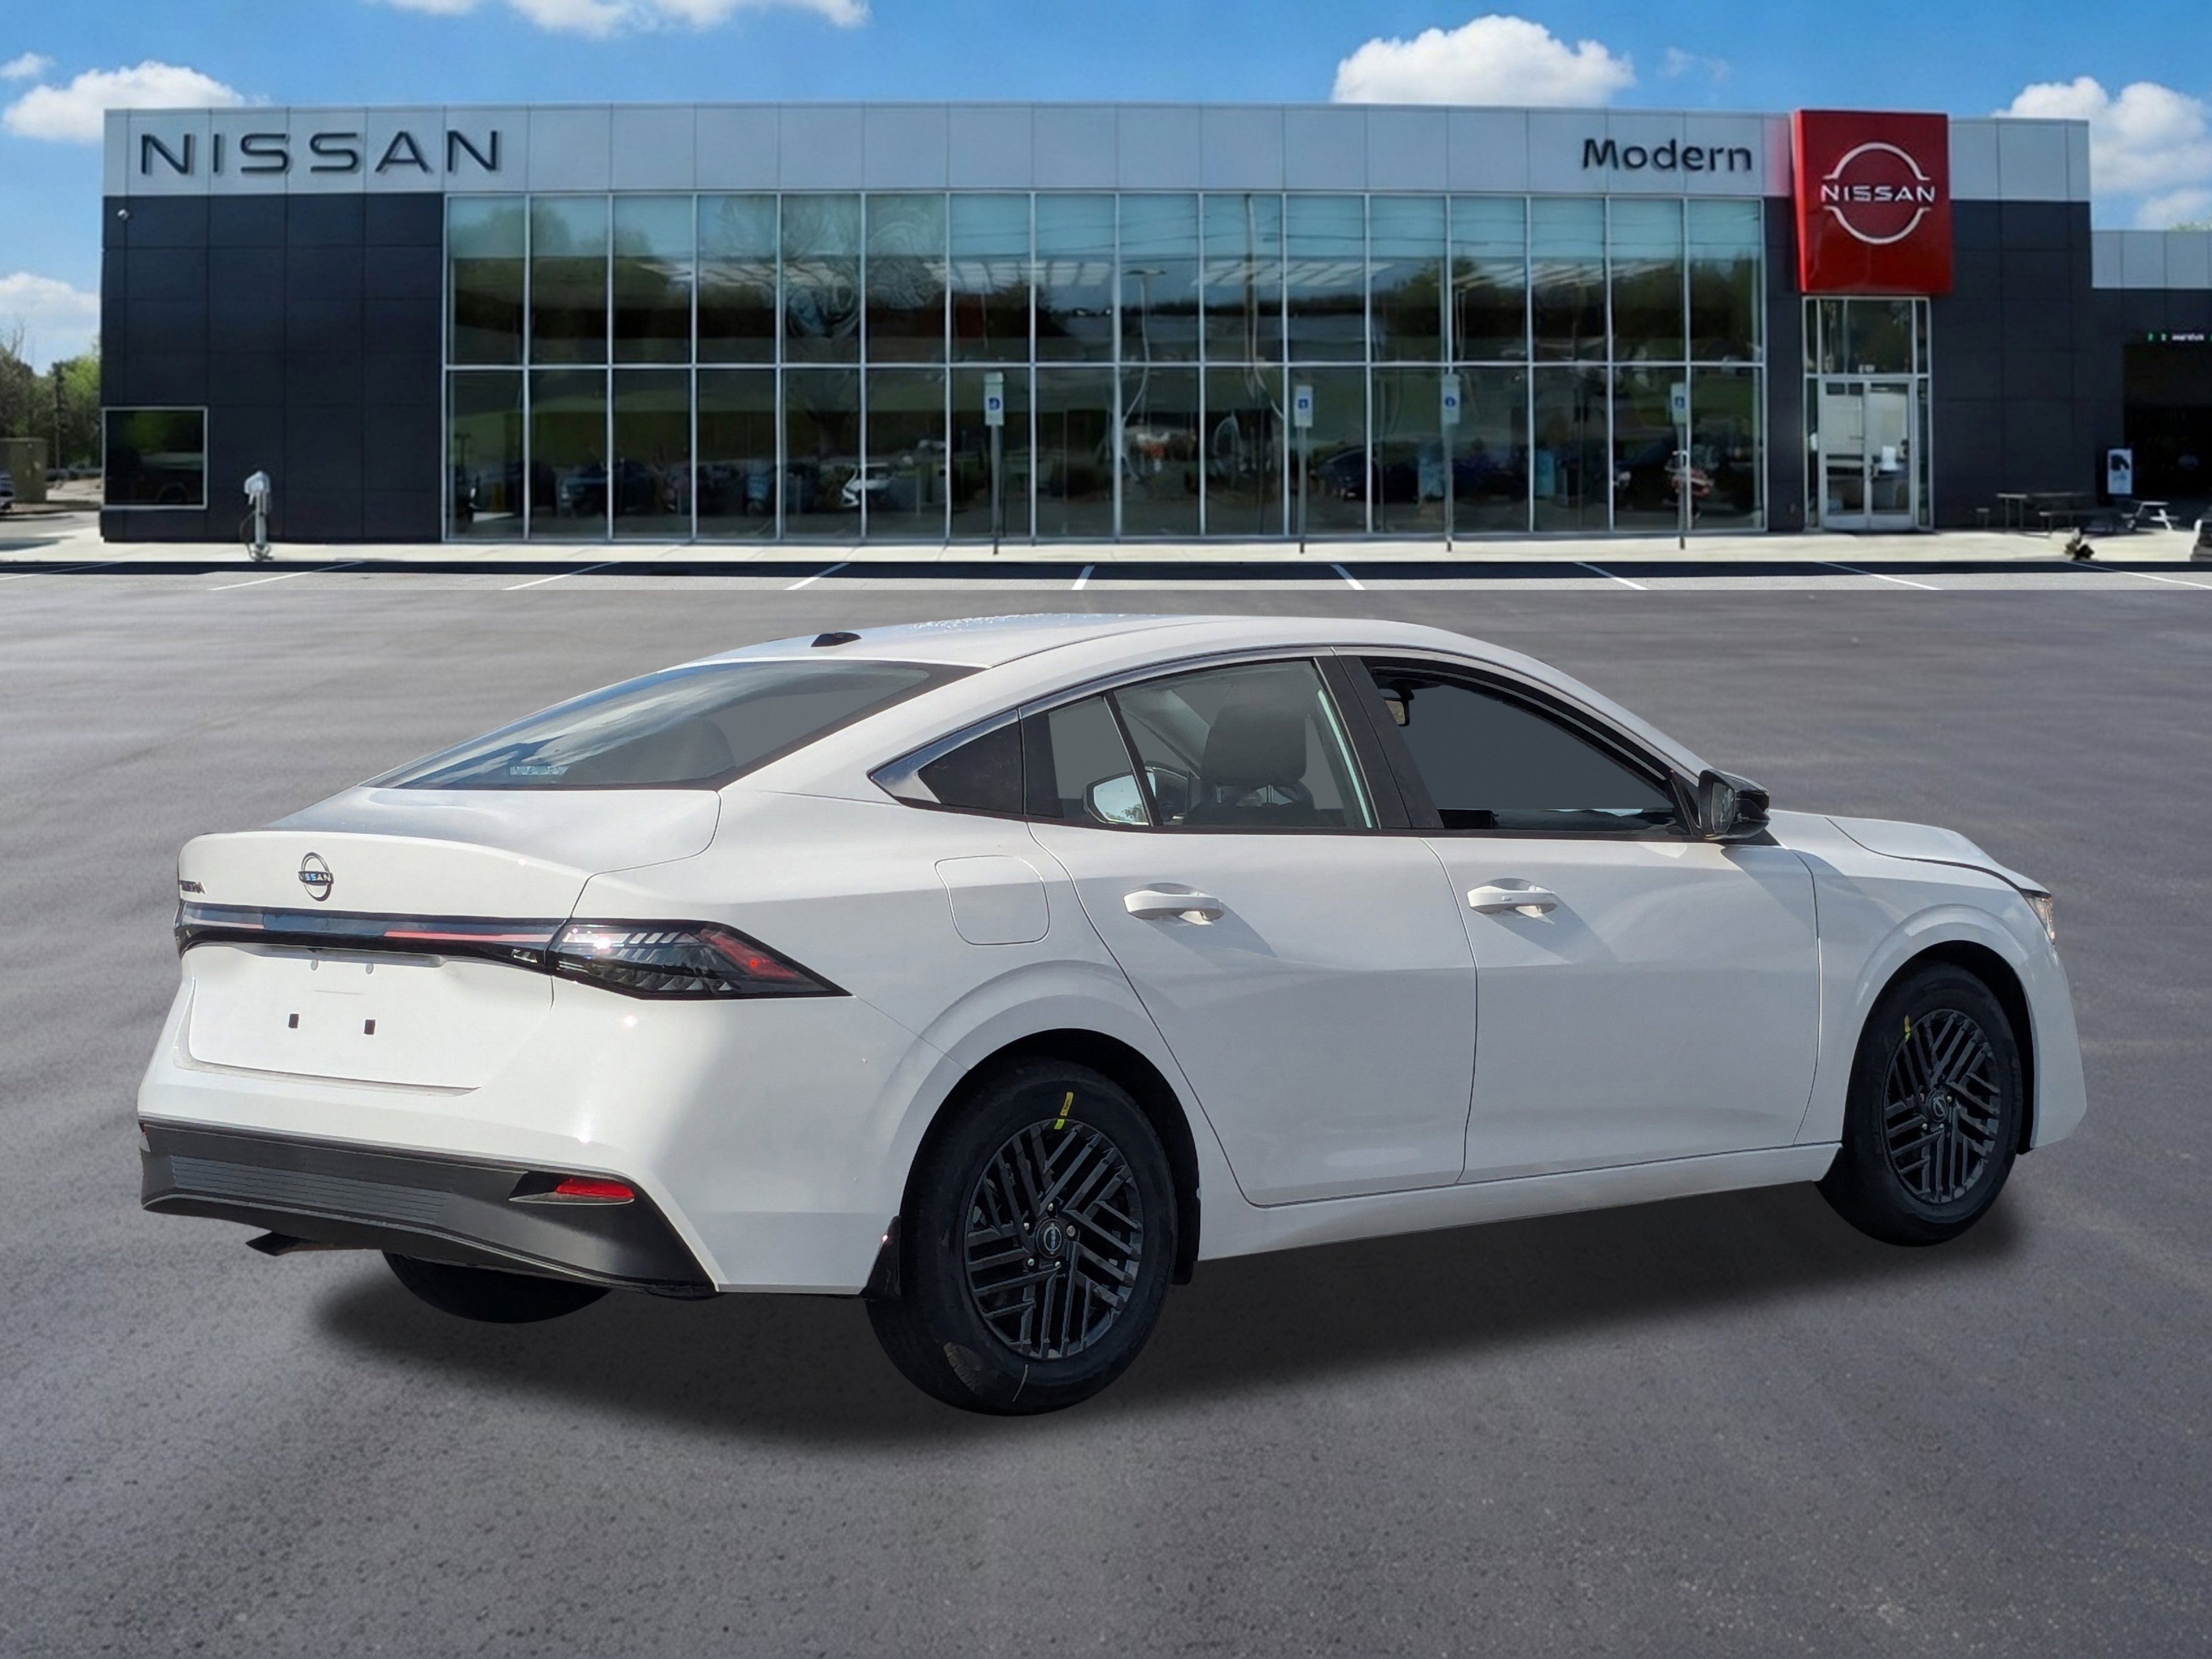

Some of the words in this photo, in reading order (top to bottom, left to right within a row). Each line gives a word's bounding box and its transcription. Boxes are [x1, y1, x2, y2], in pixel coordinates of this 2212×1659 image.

[141, 131, 498, 174] NISSAN
[1583, 139, 1752, 171] Modern
[1820, 184, 1935, 202] NISSAN
[299, 872, 332, 882] NSSAN
